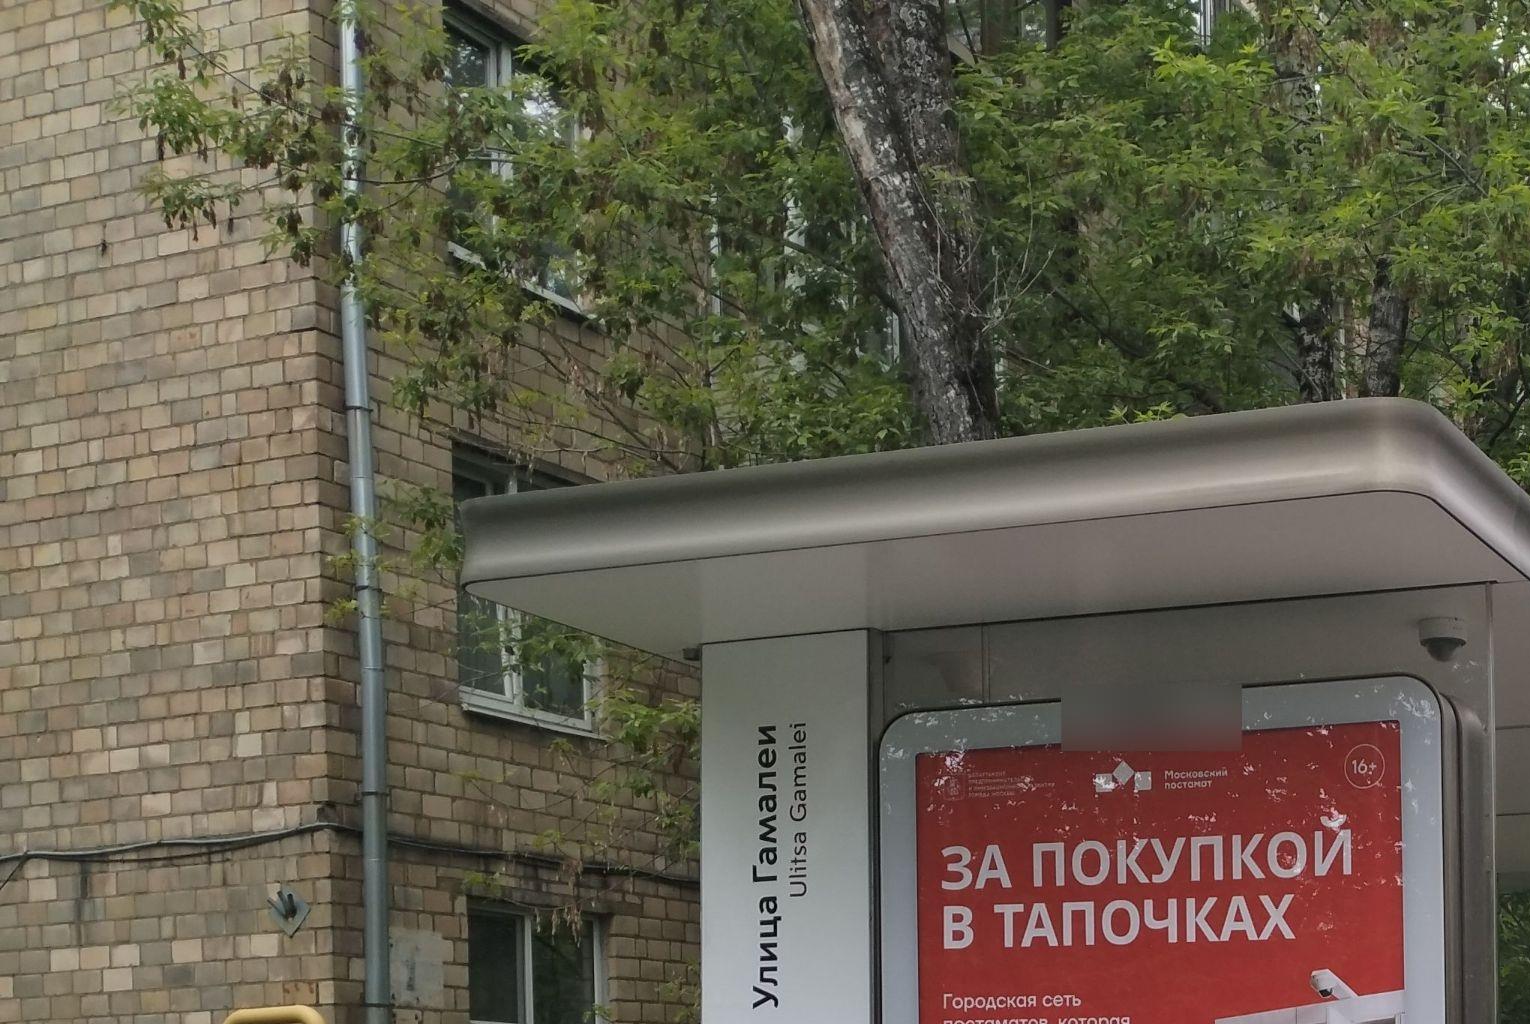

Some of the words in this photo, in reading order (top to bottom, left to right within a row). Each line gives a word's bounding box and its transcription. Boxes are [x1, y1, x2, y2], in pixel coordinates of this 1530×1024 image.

[788, 723, 806, 821] Gamalei
[1165, 767, 1227, 779] Московский
[1165, 780, 1212, 789] постамат
[1352, 759, 1377, 776] 16+
[753, 724, 778, 883] Гамалеи
[789, 832, 807, 897] Ulitsa
[942, 845, 1012, 890] ЗА
[1033, 813, 1353, 888] ПОКУПКОЙ
[944, 906, 973, 949] В
[994, 894, 1295, 947] ТАПОЧКАХ
[753, 896, 781, 1009] Улица
[944, 994, 1036, 1012] Городская
[1043, 995, 1081, 1007] сеть
